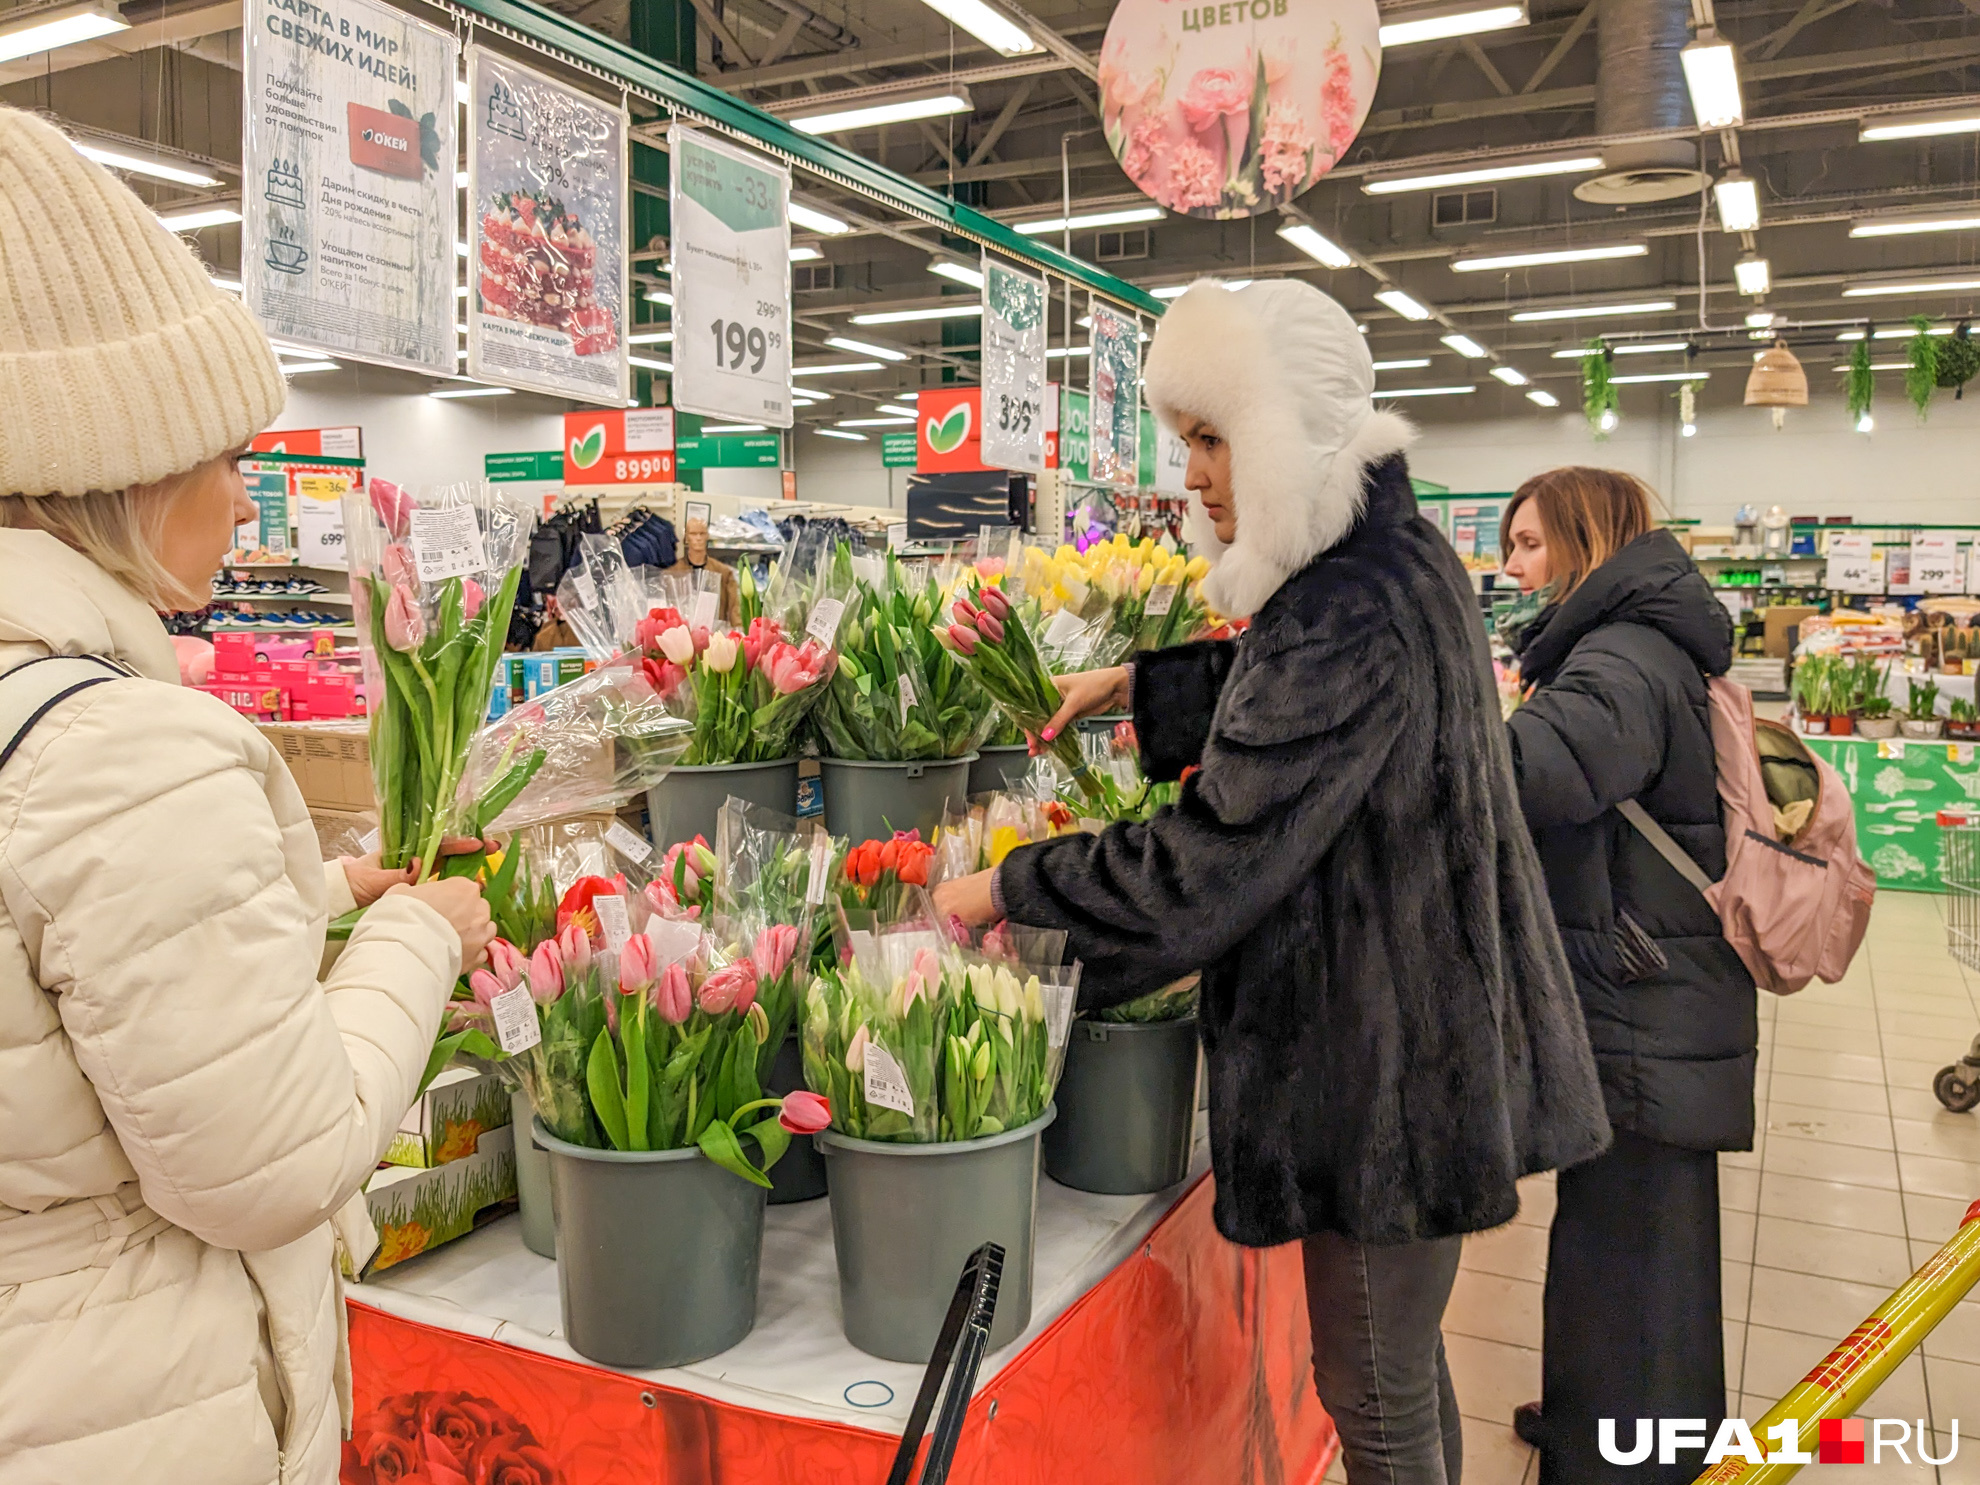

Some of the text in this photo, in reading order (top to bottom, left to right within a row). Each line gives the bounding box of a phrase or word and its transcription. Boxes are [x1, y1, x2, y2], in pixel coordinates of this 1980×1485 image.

[1182, 0, 1288, 32] ЦВЕТОВ
[340, 18, 351, 38] В
[356, 25, 399, 57] МИР
[266, 14, 418, 92] СВЕЖИХ ИДЕЙ!
[265, 87, 306, 110] больше
[266, 73, 323, 104] Получайте
[265, 102, 338, 134] удовольствия
[265, 116, 324, 143] от покупок
[321, 176, 355, 195] Дарим
[357, 190, 390, 208] скидку
[321, 191, 392, 221] Дня рождения
[320, 239, 364, 260] Угощаем
[320, 254, 368, 272] напитком
[320, 265, 343, 278] Всего
